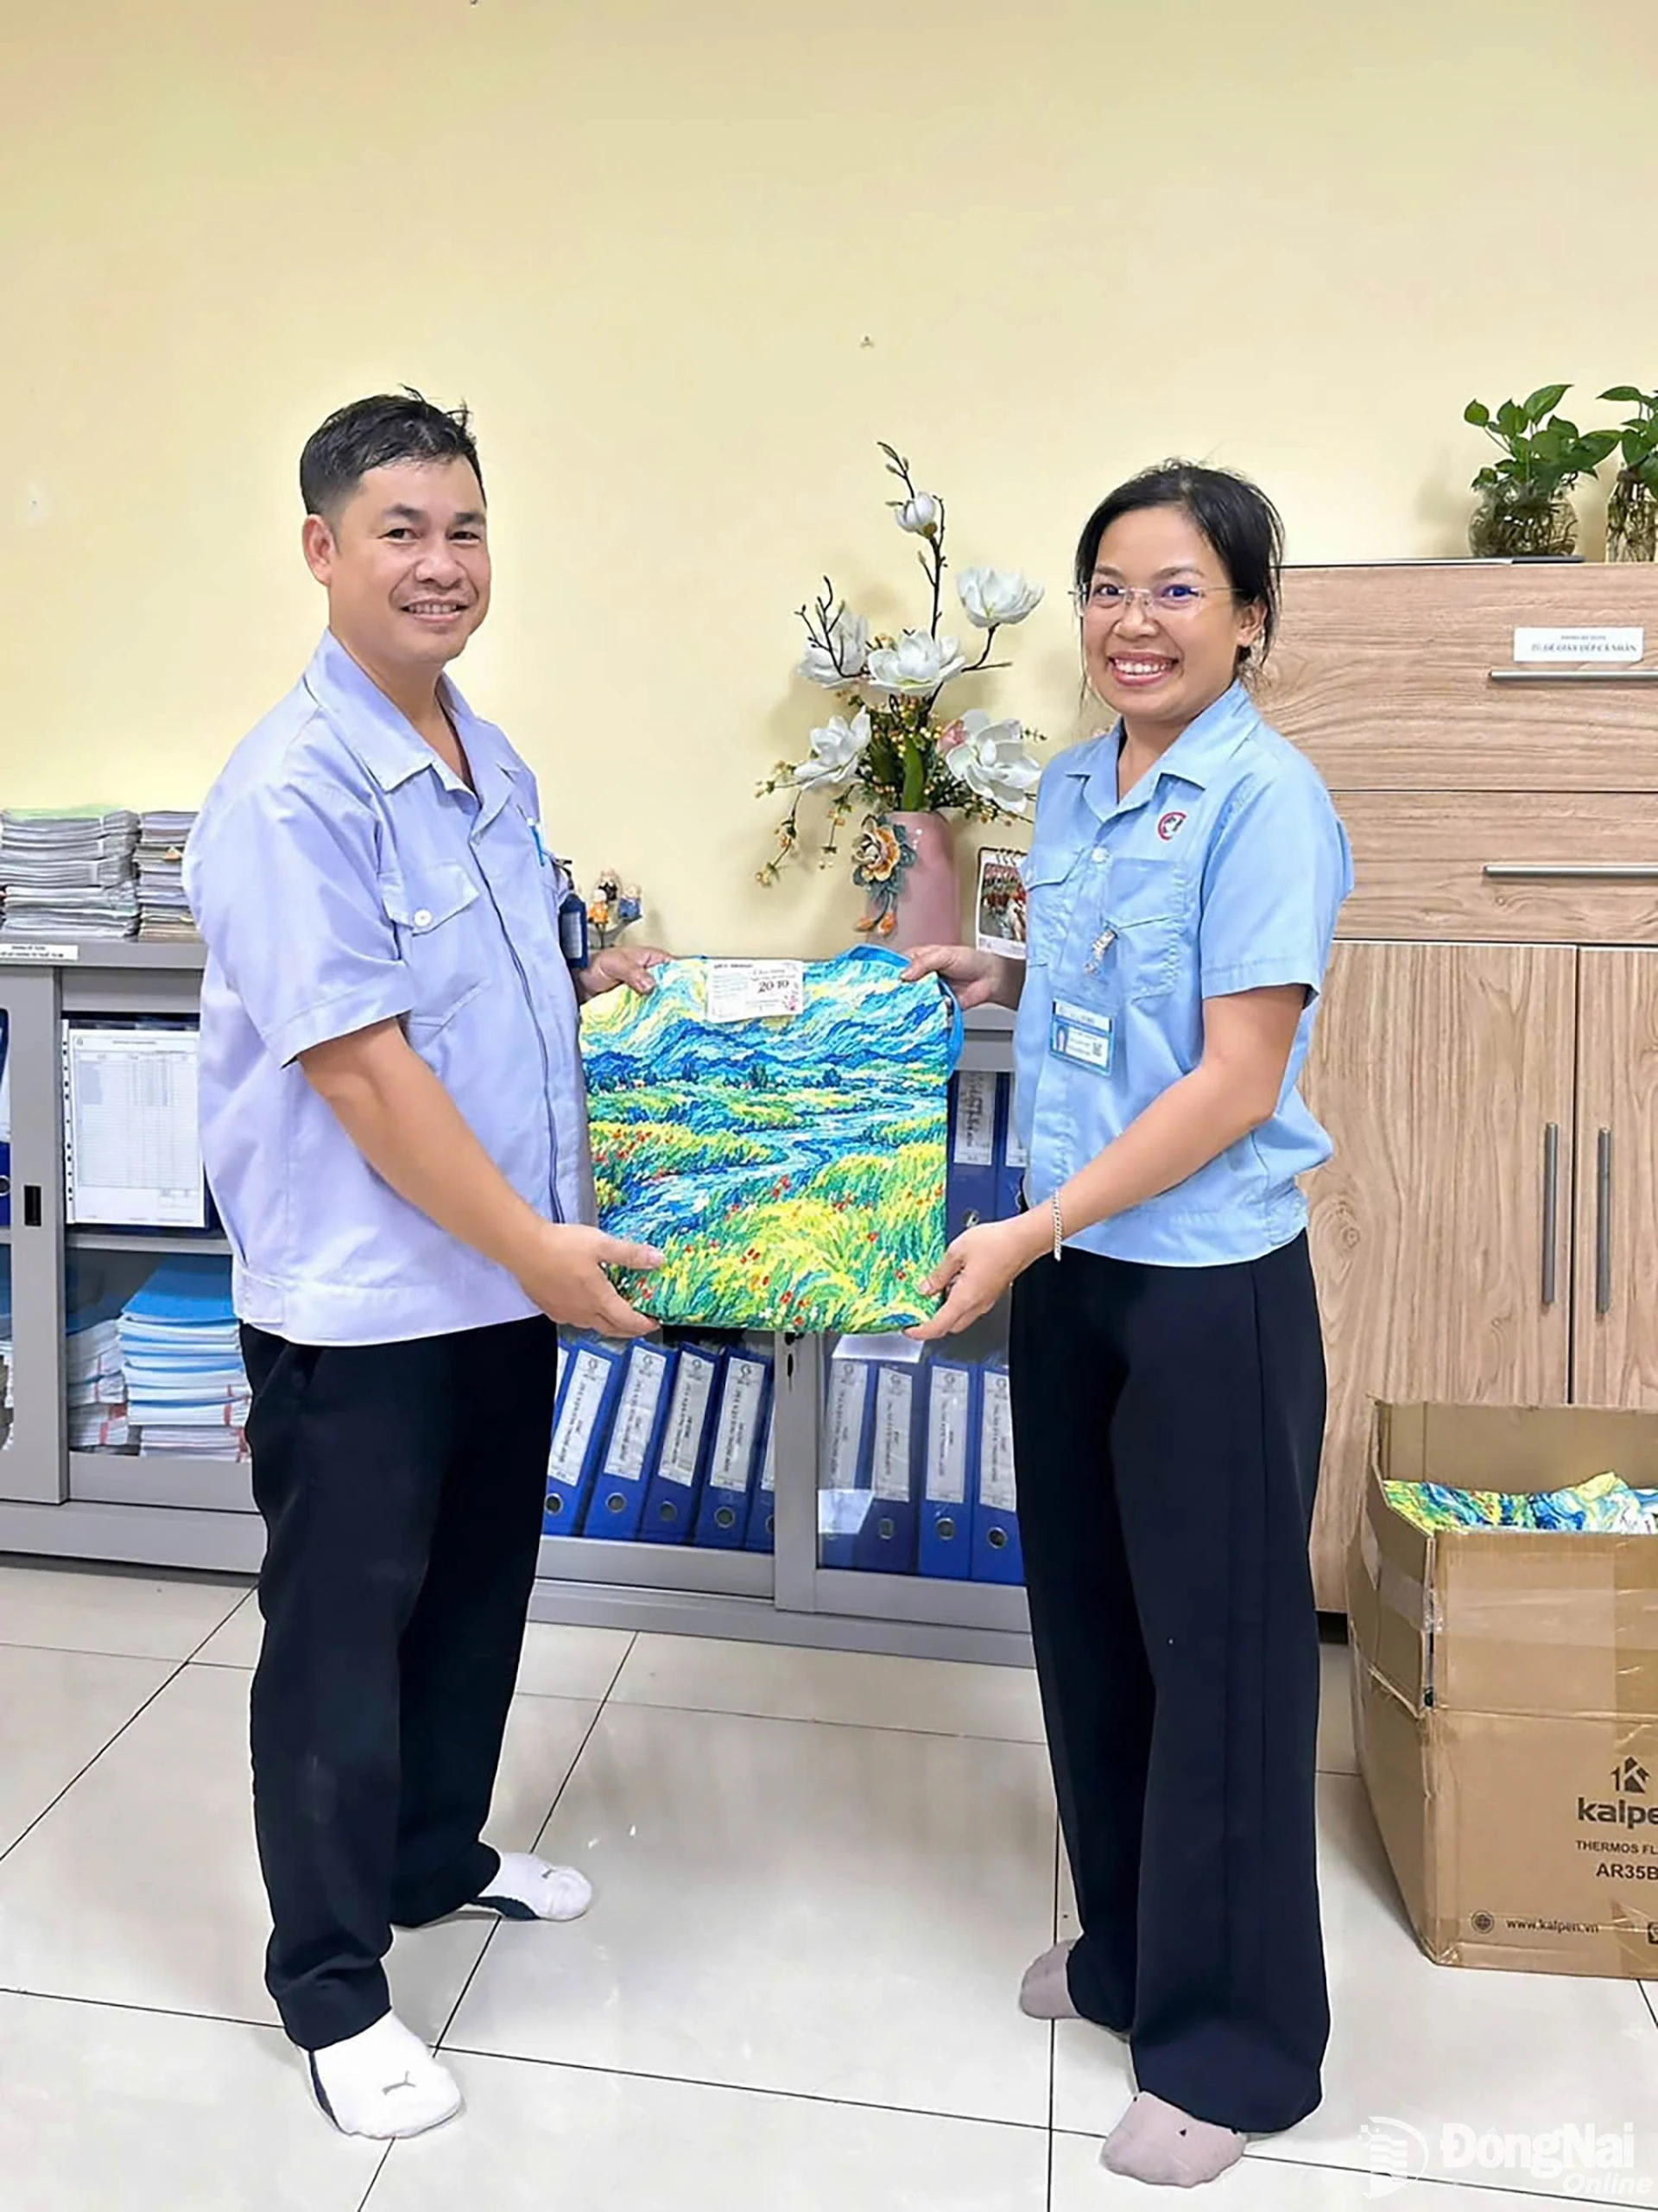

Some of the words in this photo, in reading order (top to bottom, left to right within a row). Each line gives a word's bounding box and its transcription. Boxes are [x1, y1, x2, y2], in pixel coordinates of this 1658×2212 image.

[1575, 1840, 1639, 1854] THERMOS
[1596, 1862, 1658, 1880] AR35B
[1506, 1919, 1599, 1933] www.kalpen.vn
